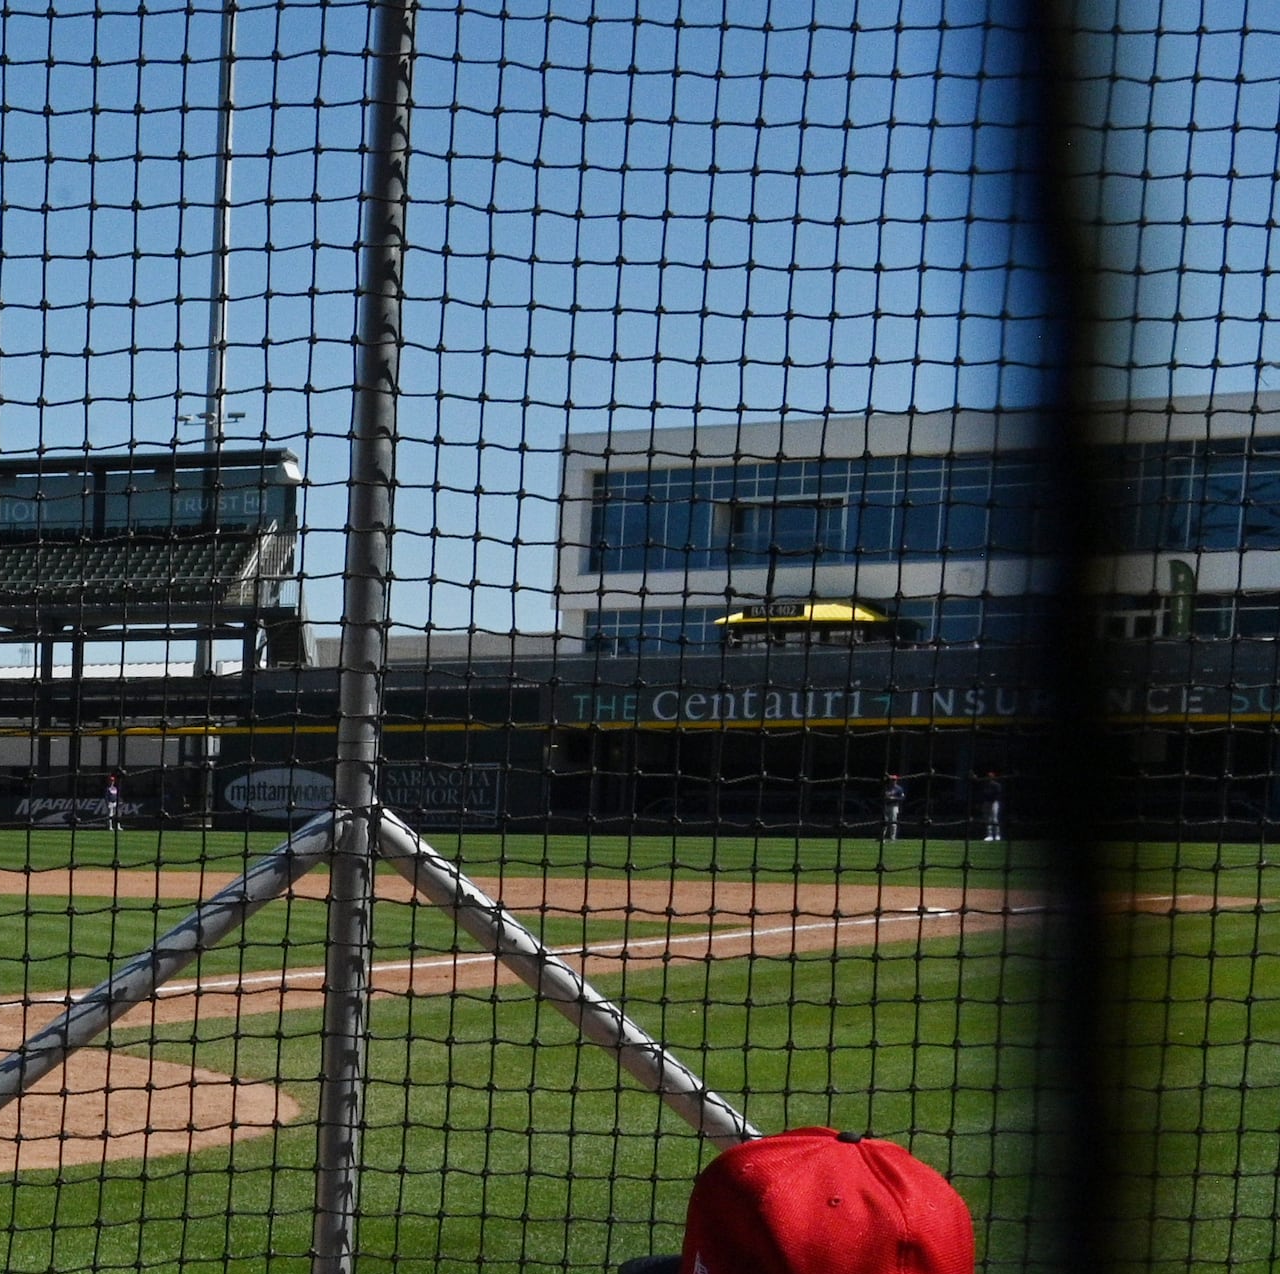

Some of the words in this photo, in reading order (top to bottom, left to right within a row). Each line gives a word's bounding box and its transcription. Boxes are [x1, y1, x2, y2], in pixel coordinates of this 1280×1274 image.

[573, 694, 638, 721] THE
[652, 684, 864, 722] Centauri
[910, 686, 1204, 718] INSUNCE
[385, 787, 491, 805] MEMORAL
